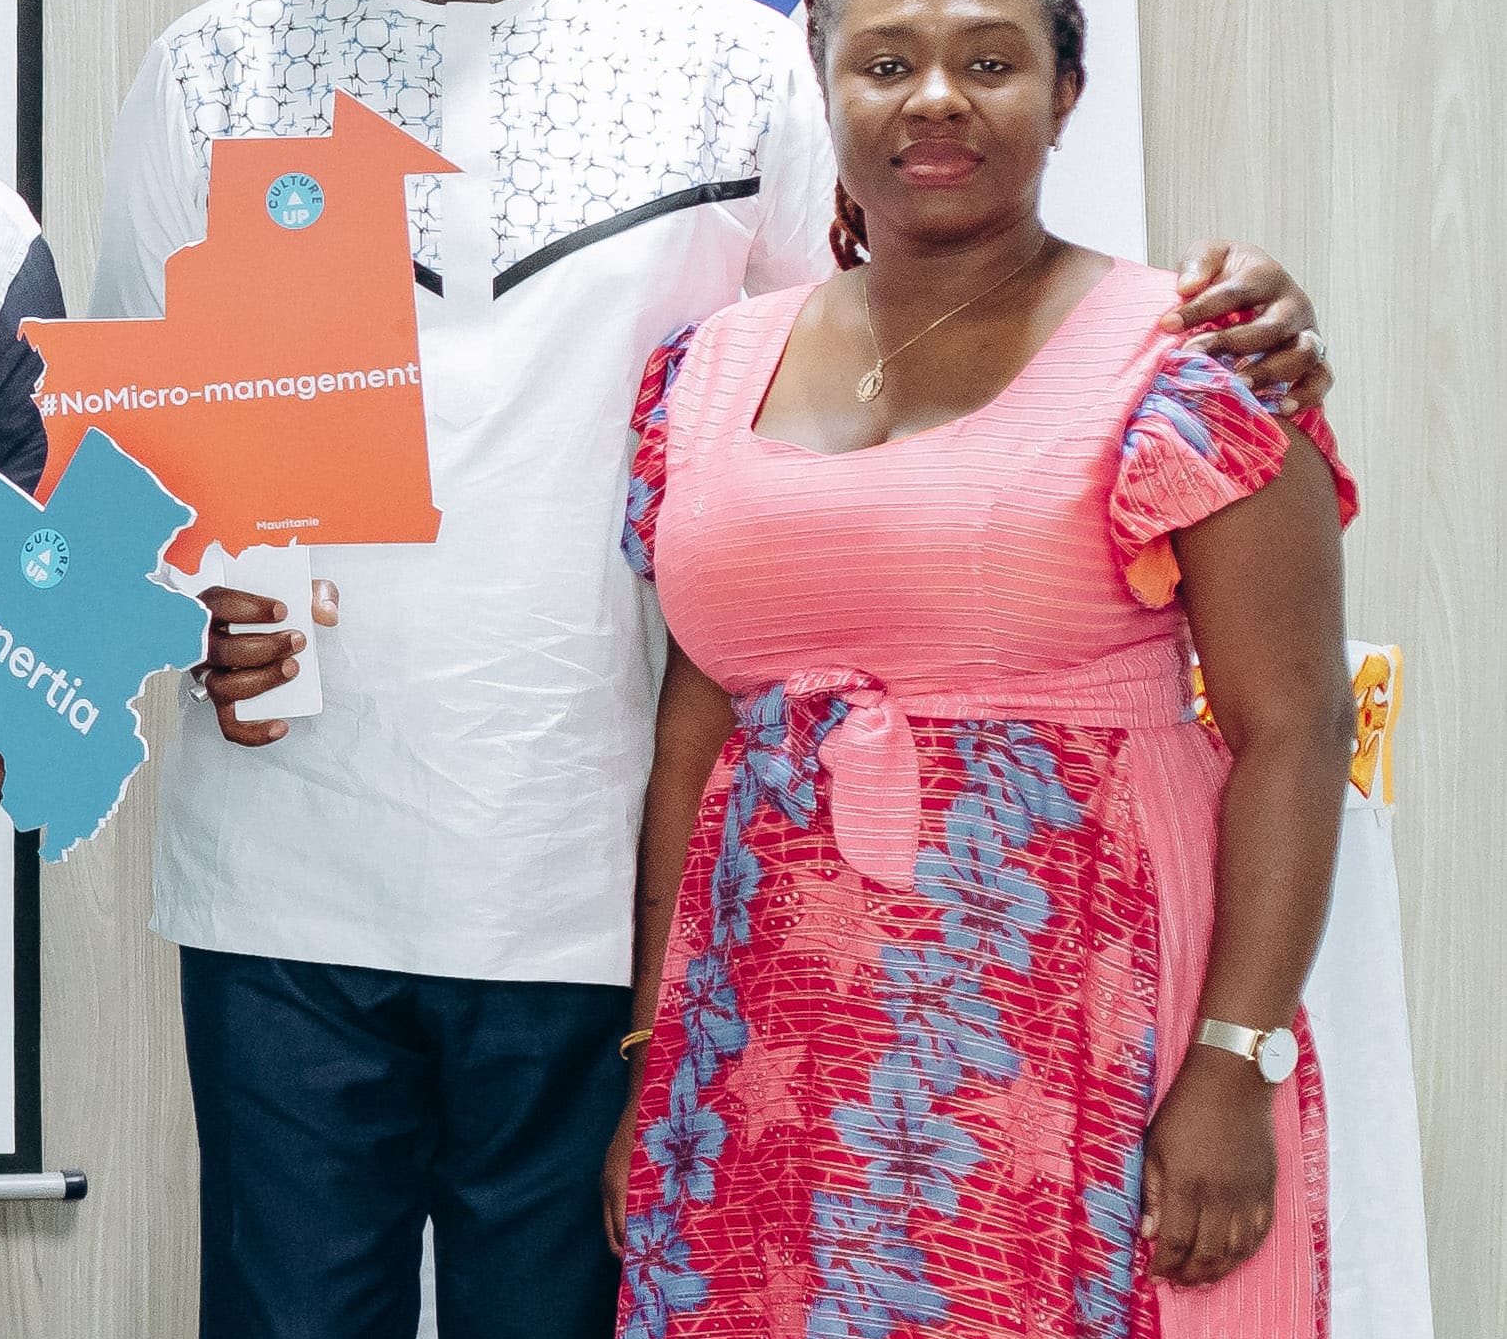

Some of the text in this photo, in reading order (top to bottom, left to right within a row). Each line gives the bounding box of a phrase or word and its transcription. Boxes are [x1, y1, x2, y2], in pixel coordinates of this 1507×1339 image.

[268, 174, 323, 210] CULTURE
[282, 210, 309, 225] UP
[41, 361, 421, 418] #NoMicro-management
[256, 517, 320, 531] Mauritanie
[24, 532, 68, 577] CULTURE
[25, 560, 49, 583] UP
